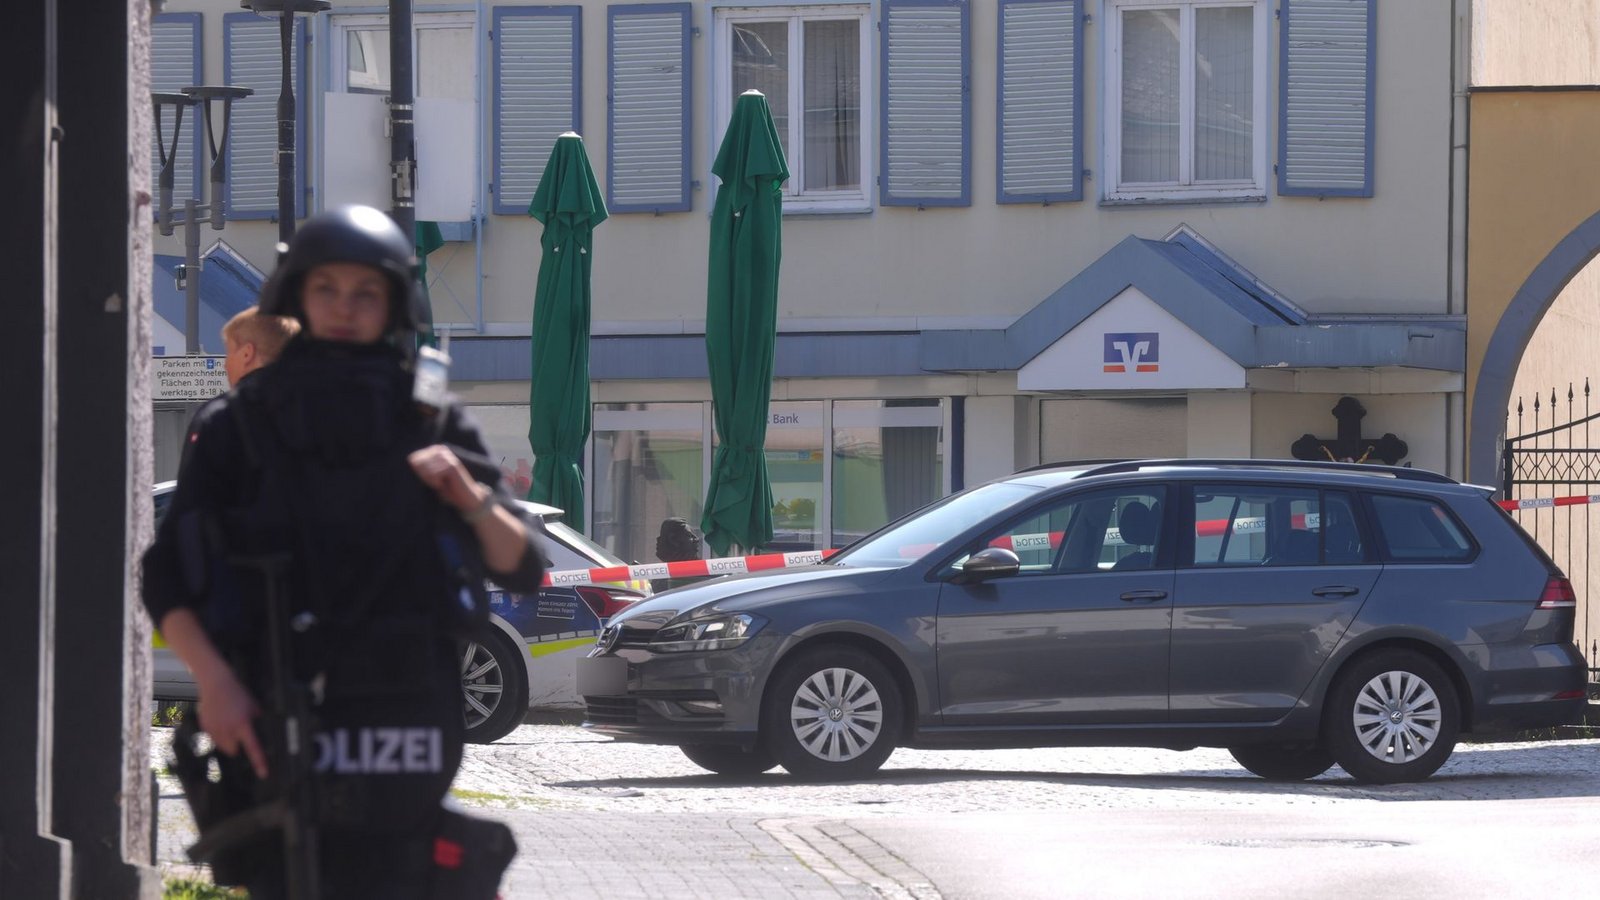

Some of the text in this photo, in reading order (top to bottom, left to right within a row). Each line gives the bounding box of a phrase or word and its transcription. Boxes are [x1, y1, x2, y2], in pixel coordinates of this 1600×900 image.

[162, 360, 191, 368] Parken
[193, 360, 206, 368] mit
[156, 370, 227, 379] gekennzeichneten
[161, 379, 192, 387] Flächen
[194, 379, 205, 387] 30
[160, 389, 198, 398] werktags
[200, 388, 217, 396] 8-18
[773, 413, 799, 424] Bank
[313, 727, 443, 773] OLIZEI
